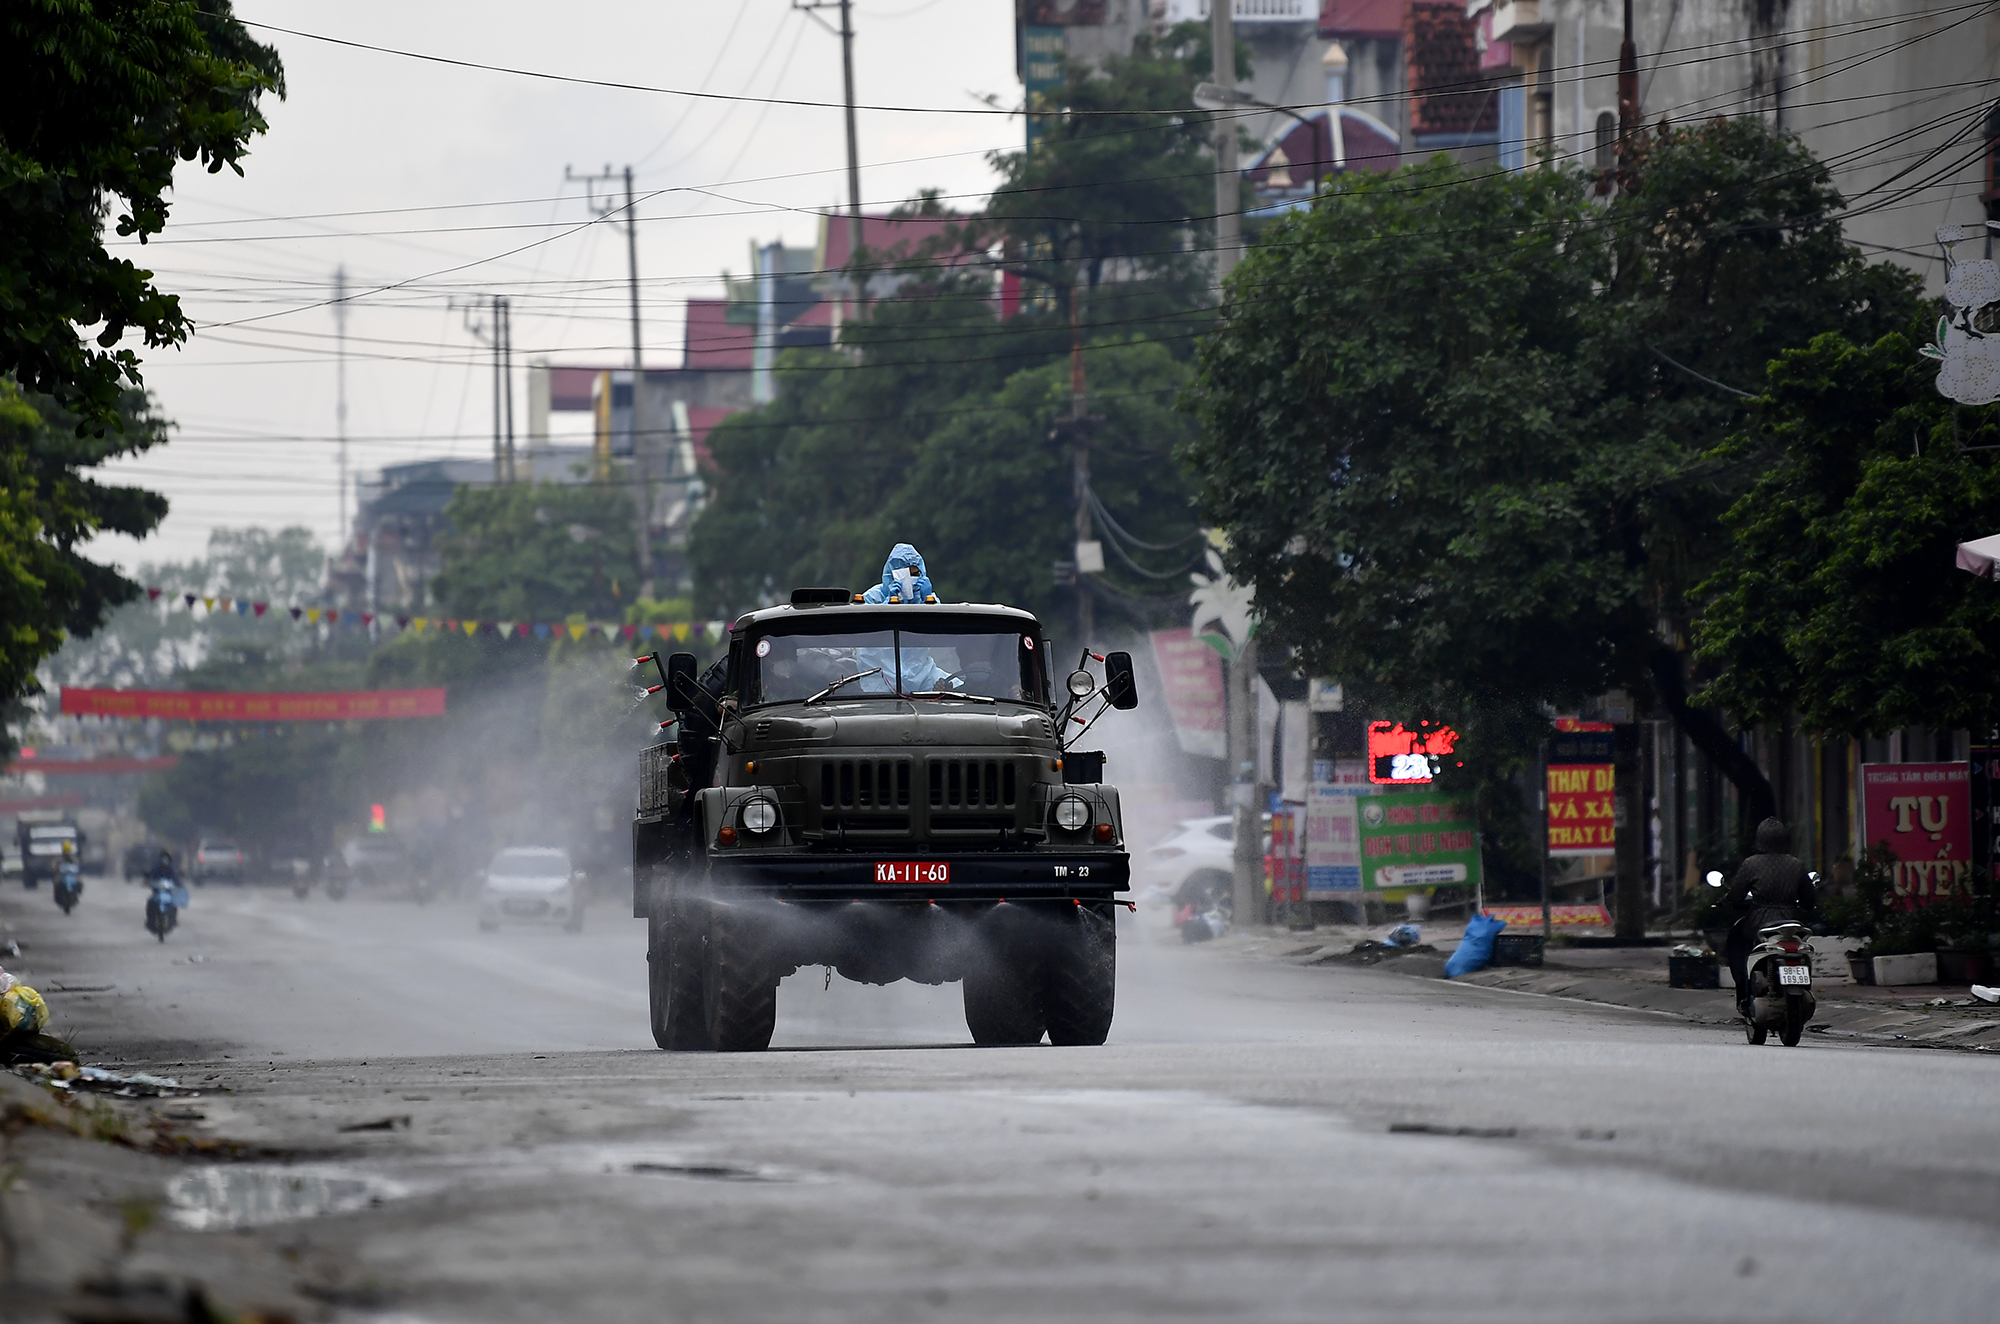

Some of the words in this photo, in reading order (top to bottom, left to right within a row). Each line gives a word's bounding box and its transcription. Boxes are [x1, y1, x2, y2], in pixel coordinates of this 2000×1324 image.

[1549, 770, 1590, 793] THAY
[1867, 772, 1899, 783] TRUNG
[1901, 770, 1921, 782] TÂM
[1923, 769, 1946, 783] ĐIỆN
[1948, 769, 1970, 781] MÁY
[1549, 797, 1579, 819] VÁ
[1890, 796, 1949, 841] TỤ
[1549, 827, 1595, 844] THAY
[877, 864, 947, 881] KA-11-60
[1054, 866, 1067, 877] TM
[1078, 866, 1090, 877] 23
[1880, 843, 1971, 905] UYẾN
[1782, 975, 1809, 984] 189.98
